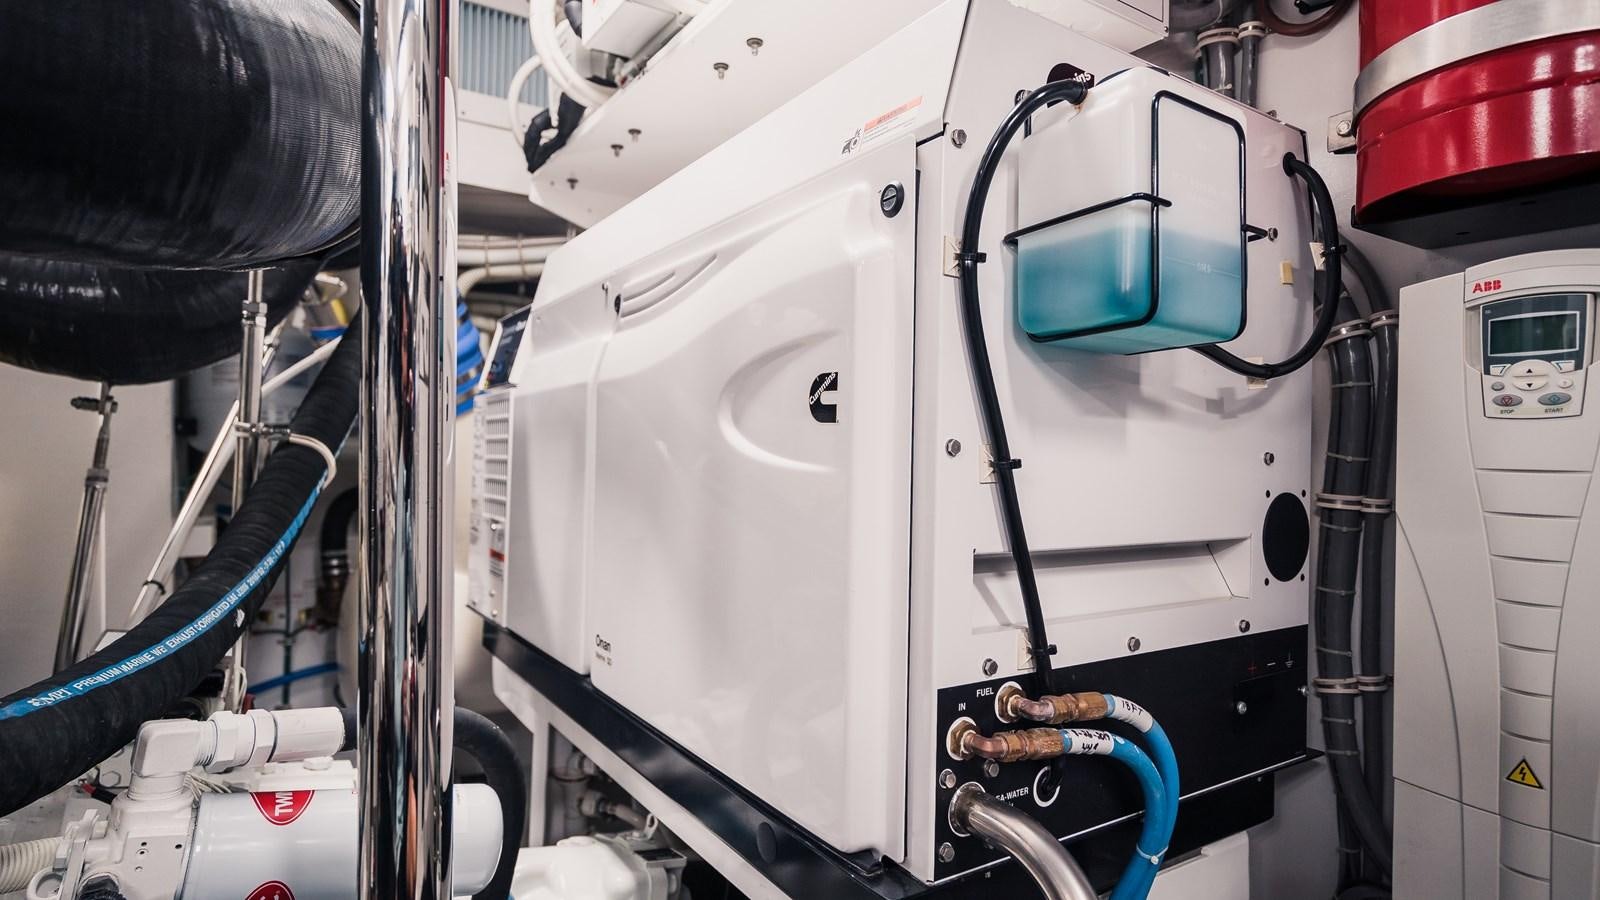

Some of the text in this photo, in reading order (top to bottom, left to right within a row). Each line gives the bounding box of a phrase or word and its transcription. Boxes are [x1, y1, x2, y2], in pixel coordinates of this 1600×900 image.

[1472, 280, 1502, 294] ABB
[809, 372, 836, 405] Cummins
[595, 633, 612, 653] Onan
[73, 667, 122, 690] PREMIUM
[976, 687, 994, 698] FUEL
[958, 702, 966, 711] IN
